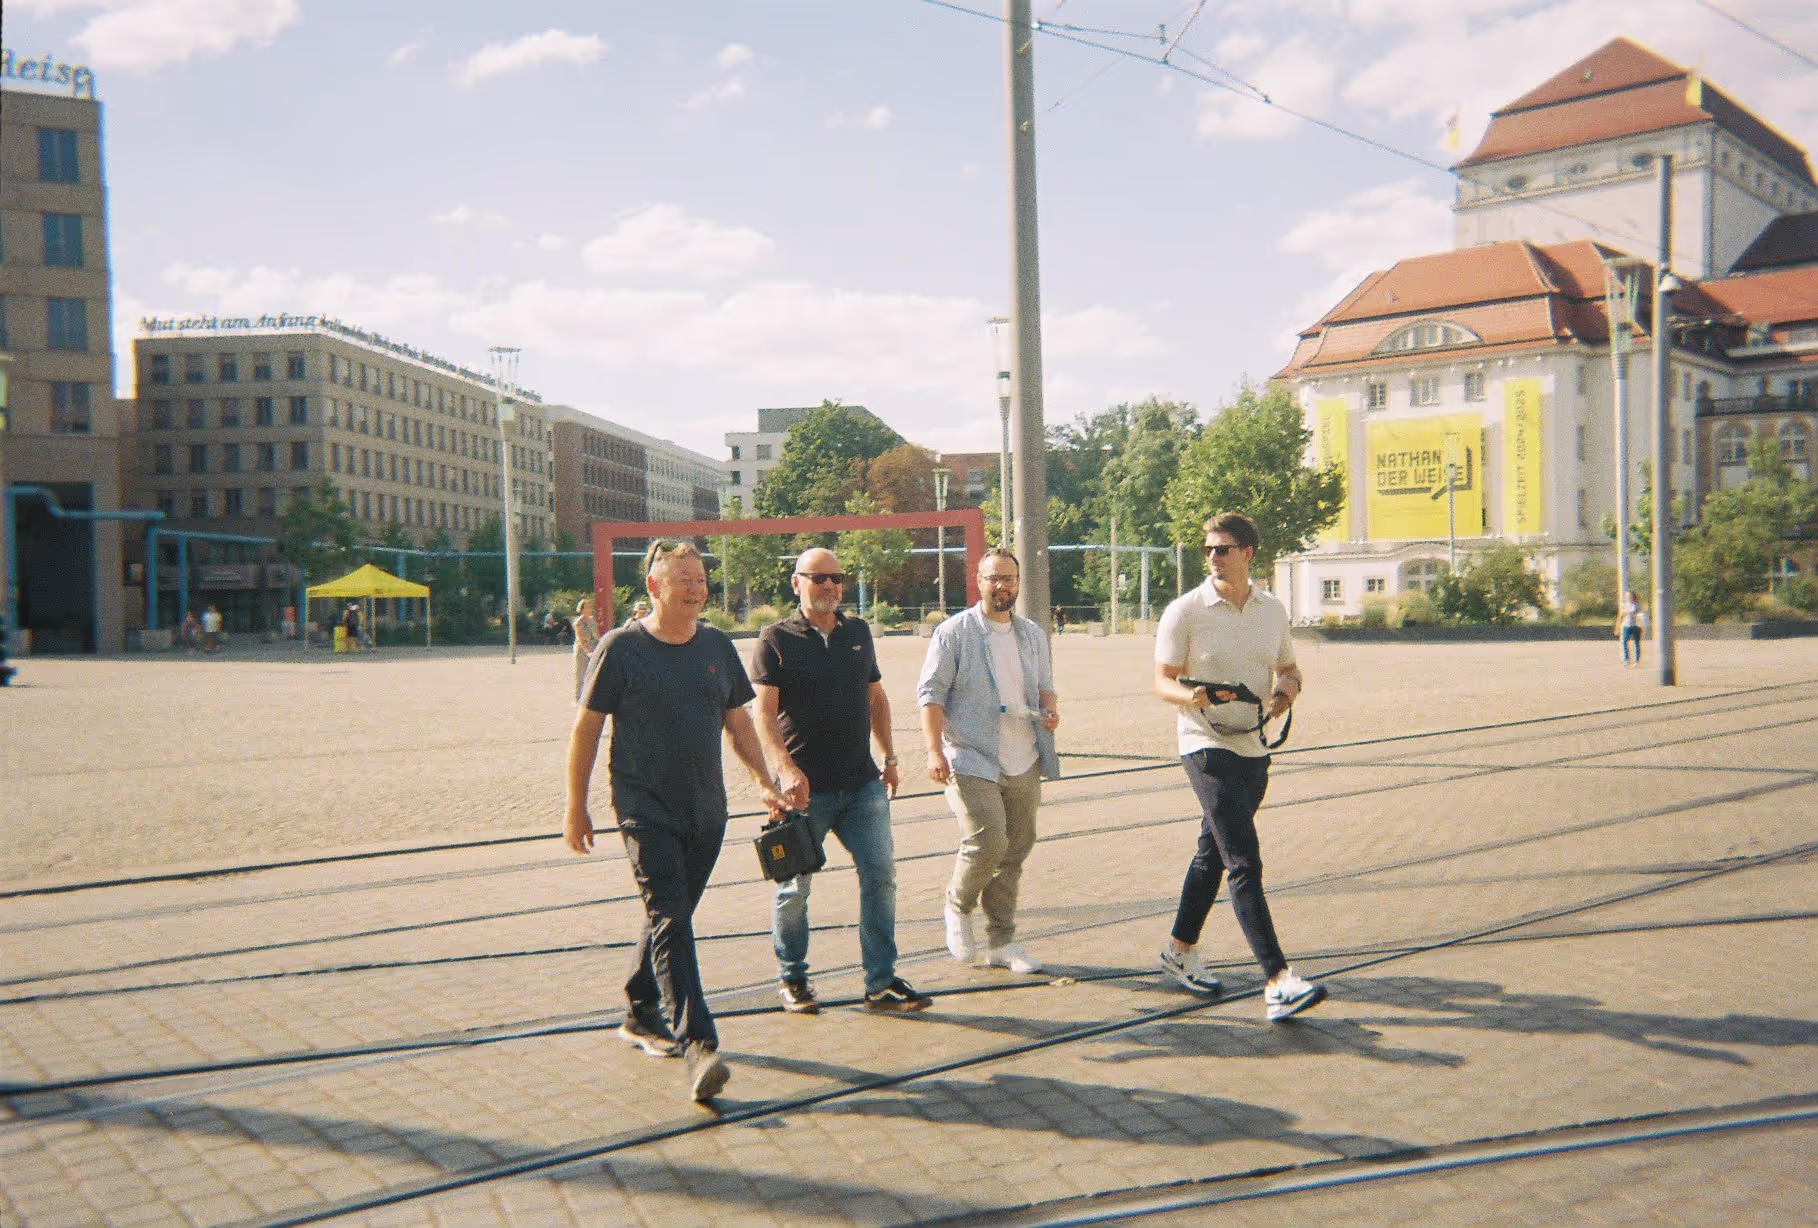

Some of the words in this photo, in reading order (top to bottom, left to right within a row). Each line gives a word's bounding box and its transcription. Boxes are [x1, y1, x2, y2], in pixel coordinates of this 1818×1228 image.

[178, 313, 218, 330] steht
[220, 317, 250, 330] am
[251, 312, 318, 333] Anfang
[1377, 450, 1441, 468] NATHAN
[1377, 470, 1408, 486] DER
[1414, 465, 1464, 484] WEIE
